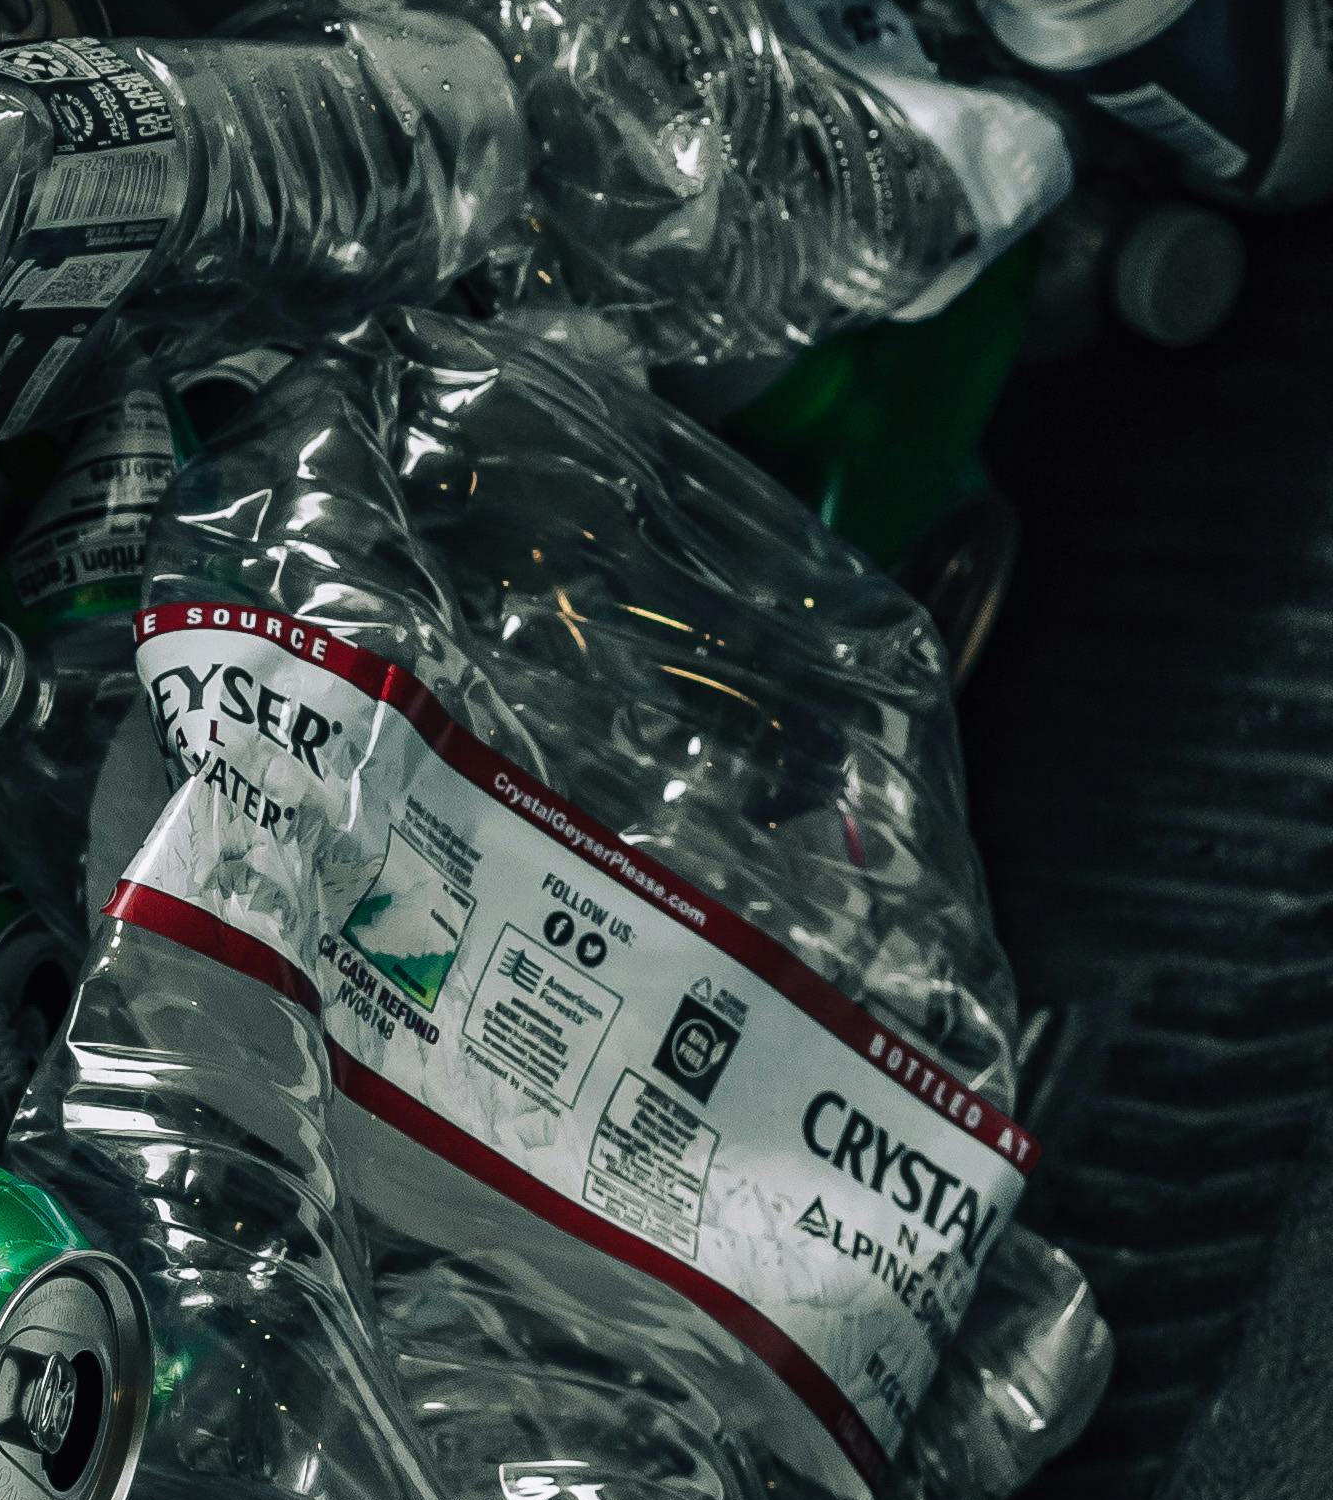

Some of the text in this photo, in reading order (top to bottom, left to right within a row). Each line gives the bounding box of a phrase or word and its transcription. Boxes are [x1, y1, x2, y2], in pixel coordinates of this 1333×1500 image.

[186, 605, 330, 663] SOURCE
[492, 770, 708, 931] CrystalGeyserPlease.com
[541, 869, 606, 931] FOLLOW
[868, 1032, 1032, 1164] BOTTLED AT
[802, 1091, 998, 1268] CRYSTAL
